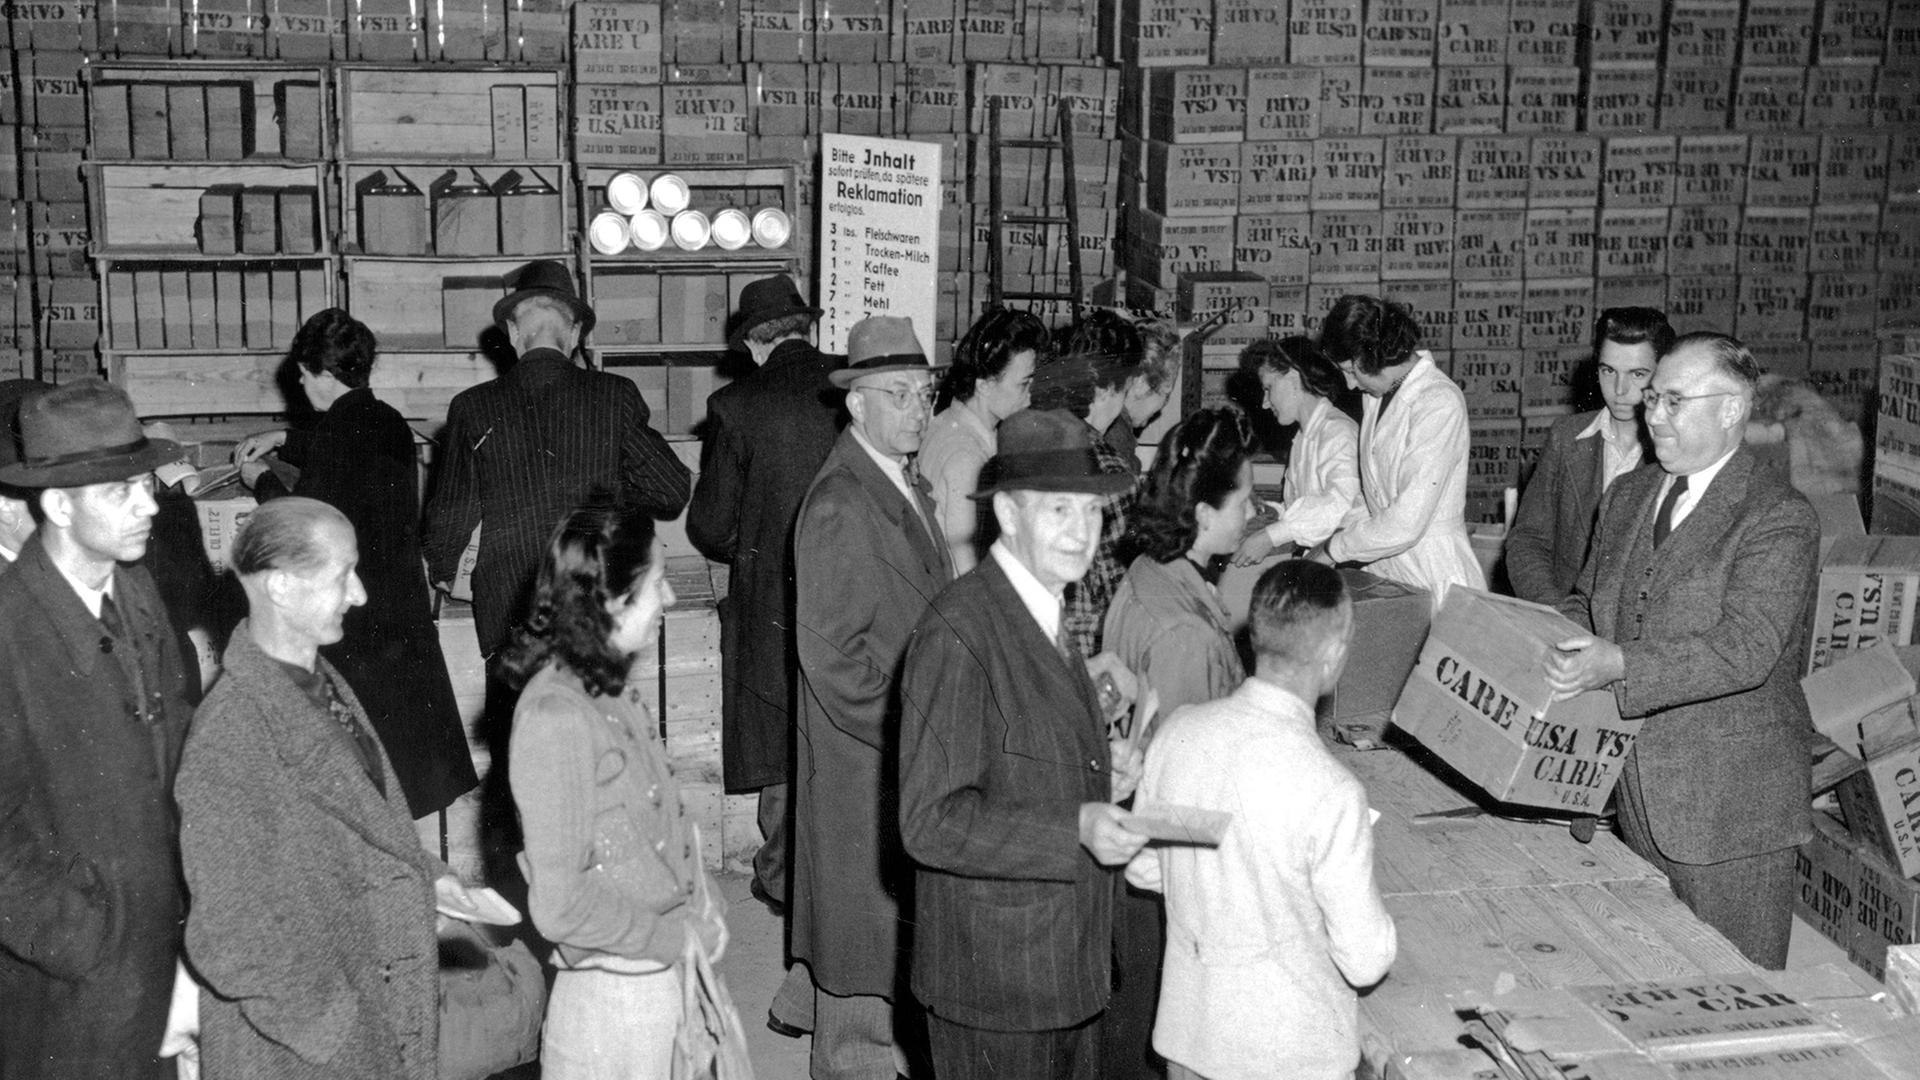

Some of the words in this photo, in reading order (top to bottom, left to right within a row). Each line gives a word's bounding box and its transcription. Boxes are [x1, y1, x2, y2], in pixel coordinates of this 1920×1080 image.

[1226, 9, 1277, 23] CARE
[1301, 7, 1351, 21] CARE
[1378, 8, 1428, 22] CARE
[1604, 13, 1652, 26] CARE
[589, 18, 649, 34] CARE
[1450, 39, 1498, 53] CARE
[1518, 40, 1567, 54] CARE
[1187, 84, 1237, 98] CARE
[1450, 78, 1497, 92] CARE
[909, 89, 958, 108] CARE
[675, 99, 735, 115] CARE
[1259, 114, 1310, 128] CARE
[1375, 111, 1423, 125] CARE
[1518, 110, 1566, 124] CARE
[1600, 112, 1646, 126] CARE
[832, 147, 855, 164] Bitte
[1253, 154, 1305, 168] CARE
[1325, 151, 1375, 163] CARE
[1395, 149, 1445, 163] CARE
[1471, 150, 1522, 164] CARE
[1542, 150, 1592, 164] CARE
[828, 166, 853, 178] sofort
[895, 174, 929, 187] spätere
[837, 181, 923, 207] Reklamation
[828, 201, 866, 217] erfolglos.
[830, 223, 837, 235] 3
[843, 227, 858, 238] lbs.
[865, 227, 920, 245] Fleischwaren
[1322, 225, 1372, 239] CARE
[1394, 222, 1444, 235] CARE
[830, 240, 837, 251] 2
[865, 243, 930, 264] Trocken-Milch
[831, 256, 836, 268] 1
[864, 260, 899, 277] Kaffee
[1466, 254, 1514, 268] CARE
[830, 274, 837, 286] 2
[864, 277, 885, 292] Fett
[829, 290, 836, 301] 7
[863, 295, 890, 310] Mehl
[1207, 296, 1260, 311] CARE
[830, 307, 836, 319] 2
[1413, 310, 1459, 325] CARE
[831, 325, 835, 336] 1
[1462, 324, 1511, 338] CARE
[1532, 322, 1582, 336] CARE
[830, 341, 835, 352] 1
[1463, 363, 1512, 376] CARE
[1436, 656, 1520, 731] CARE
[1534, 755, 1609, 789] CARE
[1802, 883, 1844, 924] CARE
[1858, 877, 1902, 922] CARE
